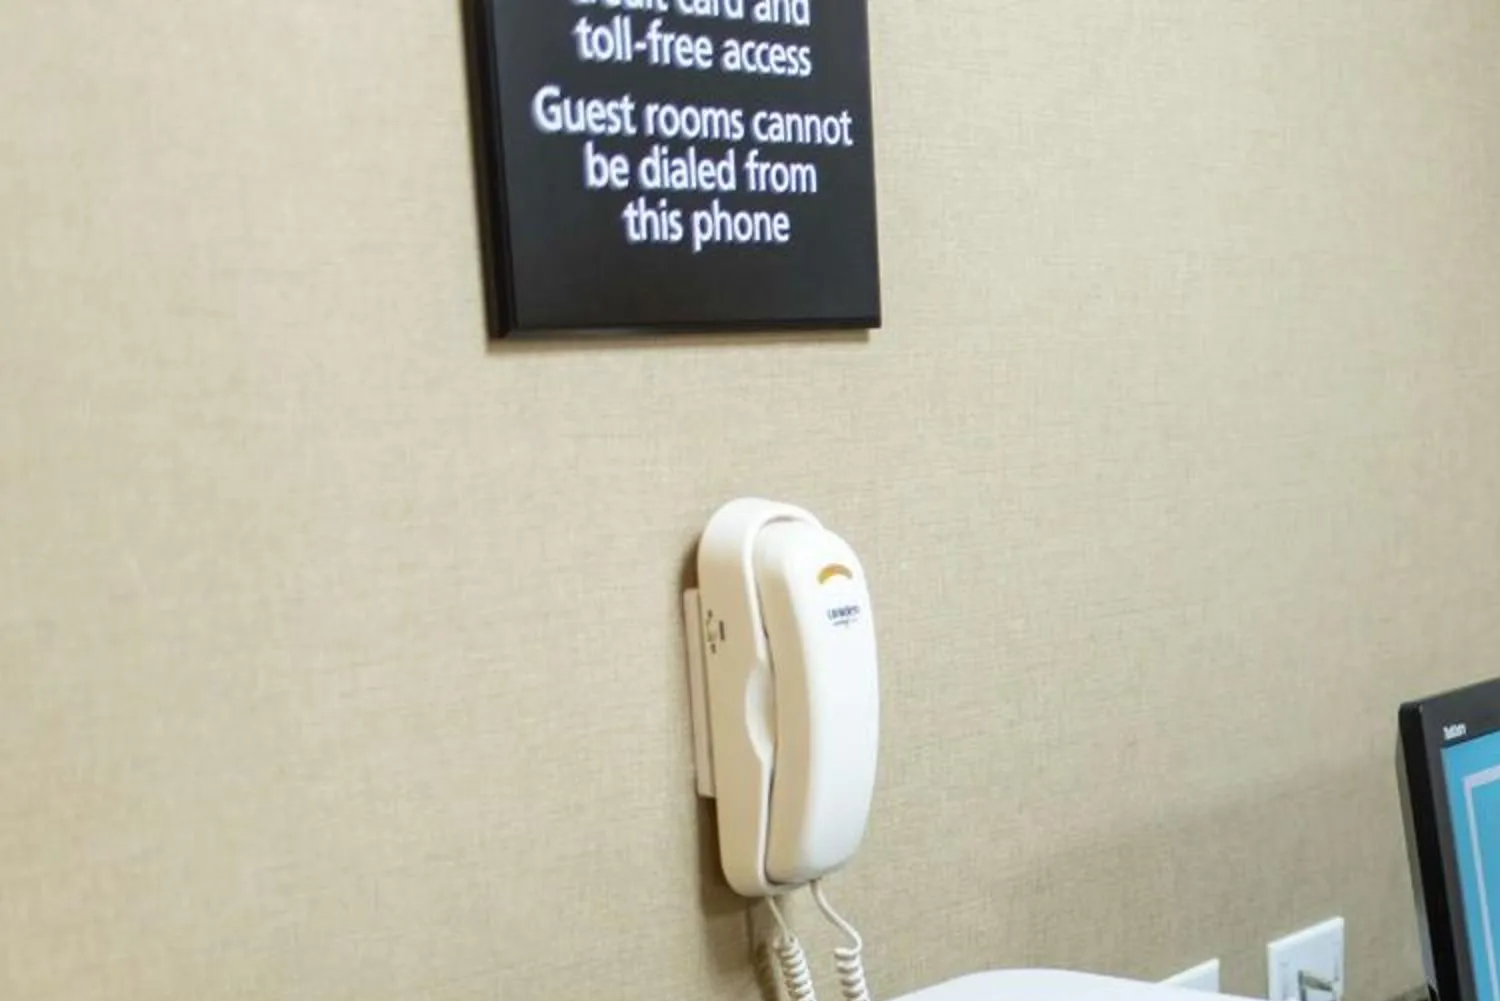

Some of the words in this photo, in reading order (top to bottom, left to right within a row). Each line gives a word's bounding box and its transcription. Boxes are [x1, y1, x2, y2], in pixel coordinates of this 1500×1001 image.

[753, 0, 810, 27] and
[573, 15, 713, 70] toll-free
[722, 37, 812, 77] access
[532, 85, 637, 136] Guest
[644, 101, 744, 140] rooms
[753, 108, 854, 147] cannot
[584, 141, 630, 190] be
[639, 145, 737, 192] dialed
[745, 149, 817, 194] from
[622, 196, 682, 243] this
[692, 200, 791, 253] phone
